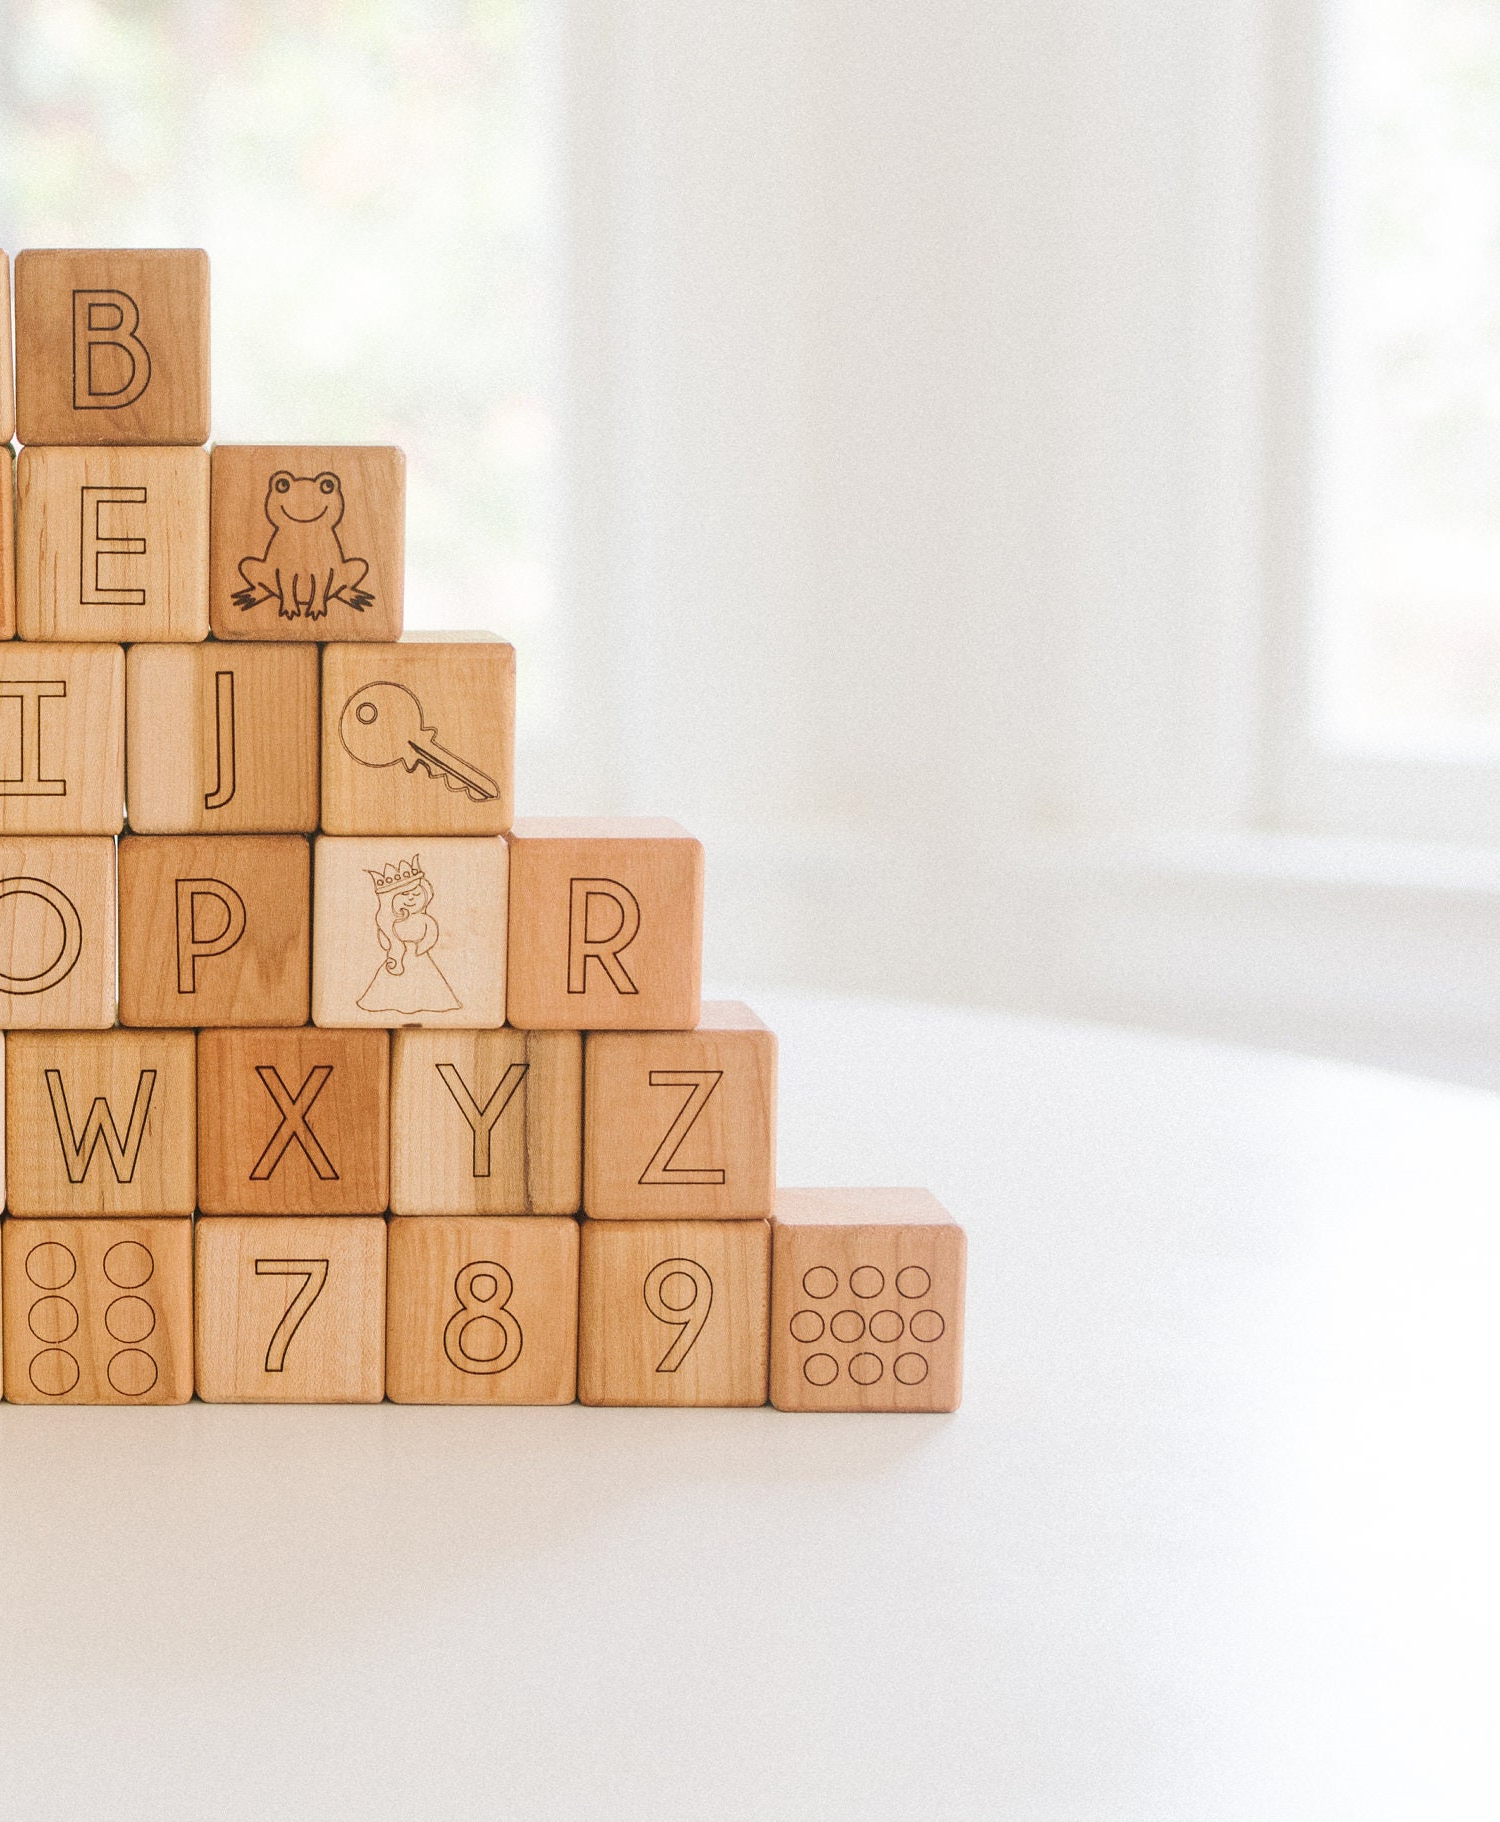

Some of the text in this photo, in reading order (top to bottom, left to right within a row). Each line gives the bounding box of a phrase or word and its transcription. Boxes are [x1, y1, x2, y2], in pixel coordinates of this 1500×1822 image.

[71, 288, 152, 411] B
[79, 485, 147, 606] E
[204, 669, 234, 810] J
[173, 877, 248, 995] P
[567, 876, 641, 996] R
[43, 1068, 158, 1184] W
[248, 1065, 340, 1181] X
[434, 1062, 531, 1179] Y
[636, 1070, 726, 1185] Z
[254, 1257, 329, 1373] 7
[442, 1260, 524, 1375] 8
[642, 1257, 714, 1373] 9
